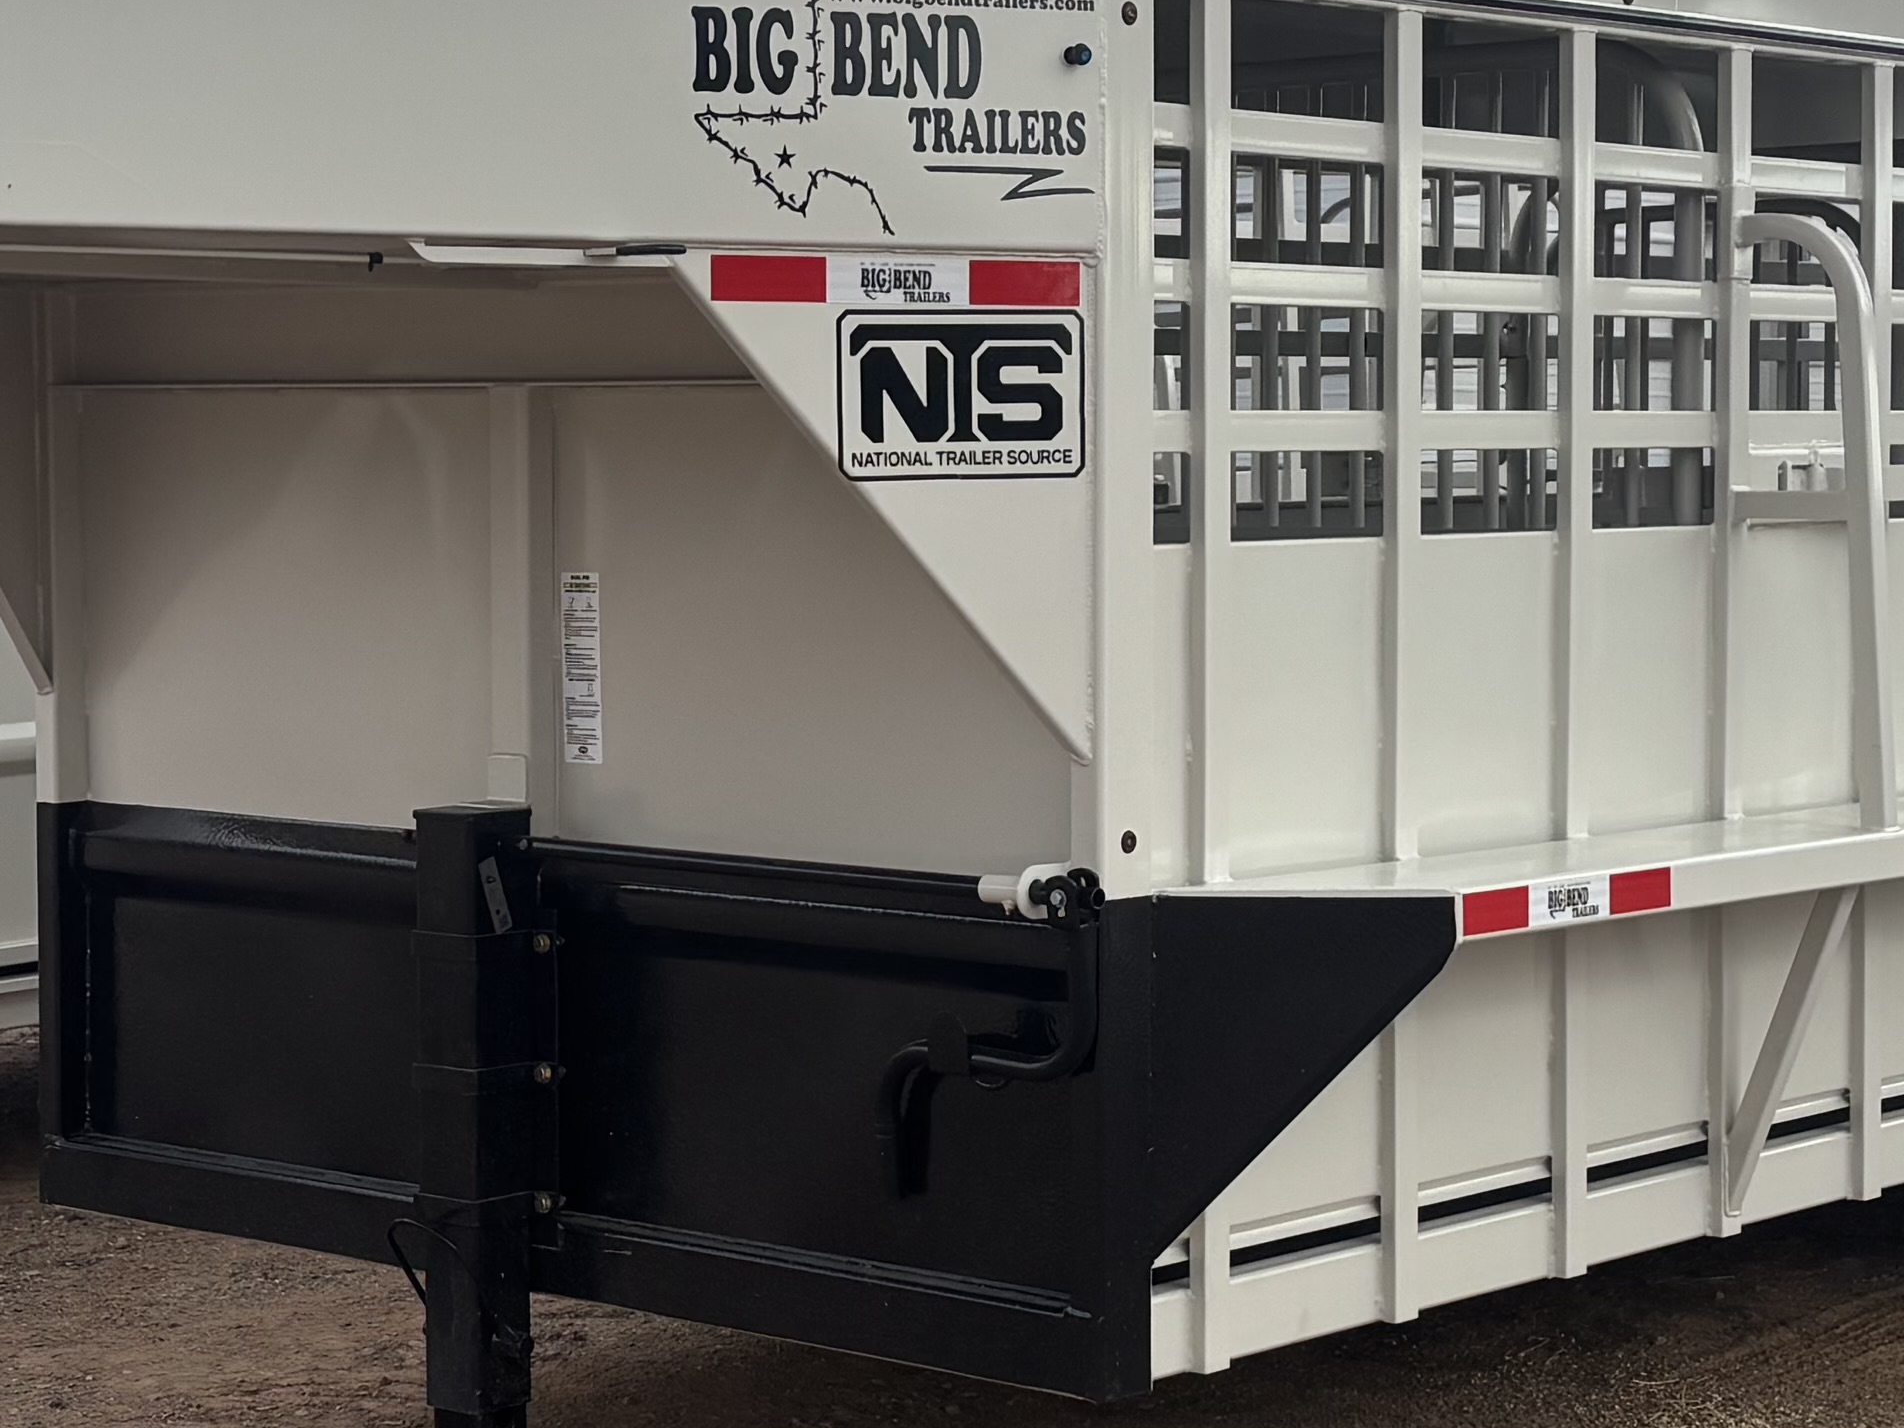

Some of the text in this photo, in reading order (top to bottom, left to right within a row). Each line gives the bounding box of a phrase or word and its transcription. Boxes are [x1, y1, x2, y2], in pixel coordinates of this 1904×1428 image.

[691, 5, 982, 100] BIG BEND
[908, 107, 1086, 156] TRAILERS
[860, 267, 932, 290] BIG BEND
[903, 291, 951, 303] TRAILERS
[849, 323, 1073, 444] NTS
[851, 449, 1073, 468] NATIONAL TRAILER SOURCE
